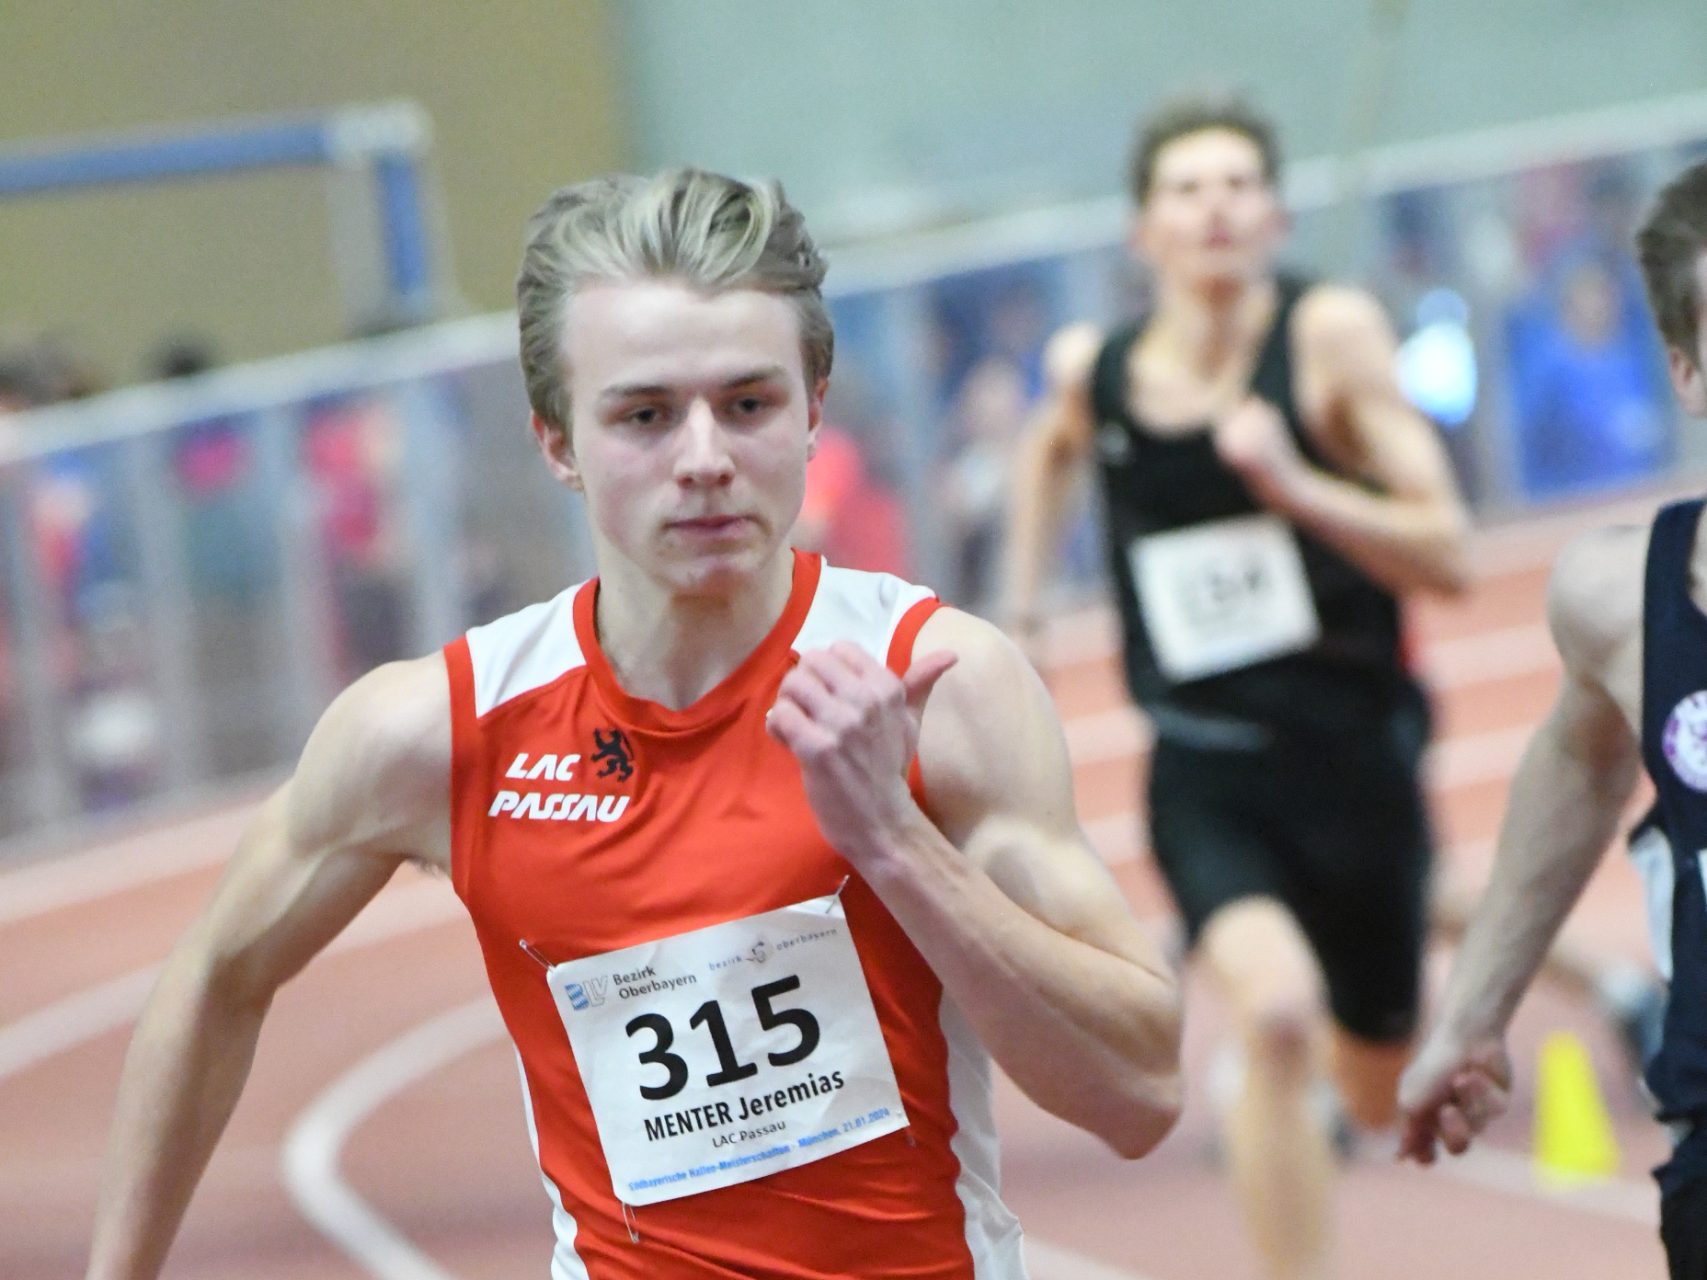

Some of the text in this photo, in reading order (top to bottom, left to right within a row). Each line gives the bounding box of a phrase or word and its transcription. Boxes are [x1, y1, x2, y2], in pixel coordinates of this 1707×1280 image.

[505, 752, 581, 781] LAC
[488, 790, 630, 822] PASSAU
[612, 965, 656, 986] Bezirk
[618, 974, 697, 1000] Oberbayern
[624, 974, 821, 1102] 315
[643, 1070, 844, 1142] MENTER Jeremias
[712, 1120, 787, 1148] LAC Passau
